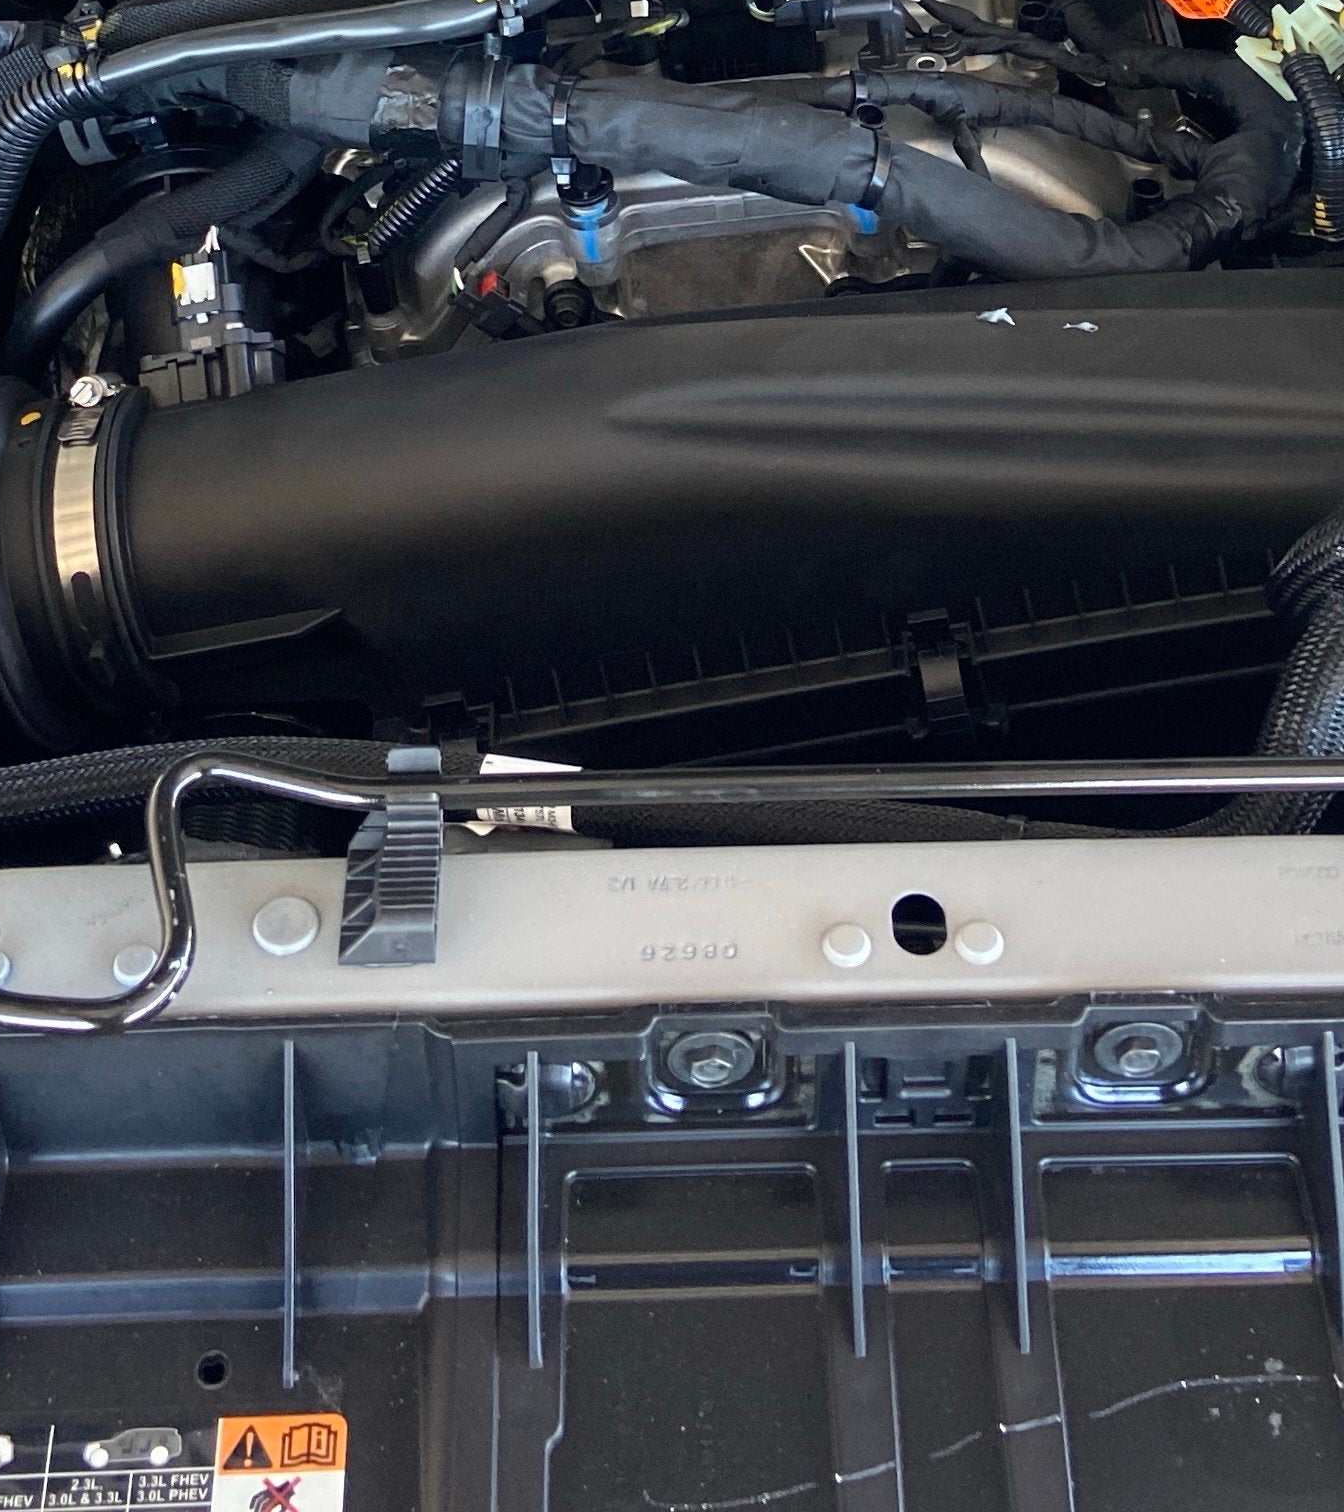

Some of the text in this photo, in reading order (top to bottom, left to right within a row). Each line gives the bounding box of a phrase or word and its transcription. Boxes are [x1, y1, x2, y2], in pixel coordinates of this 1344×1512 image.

[139, 1473, 210, 1488] 3.3L FHEV
[48, 1491, 123, 1506] 3.0L & 3.3L
[137, 1487, 209, 1503] 3.0L PHEV
